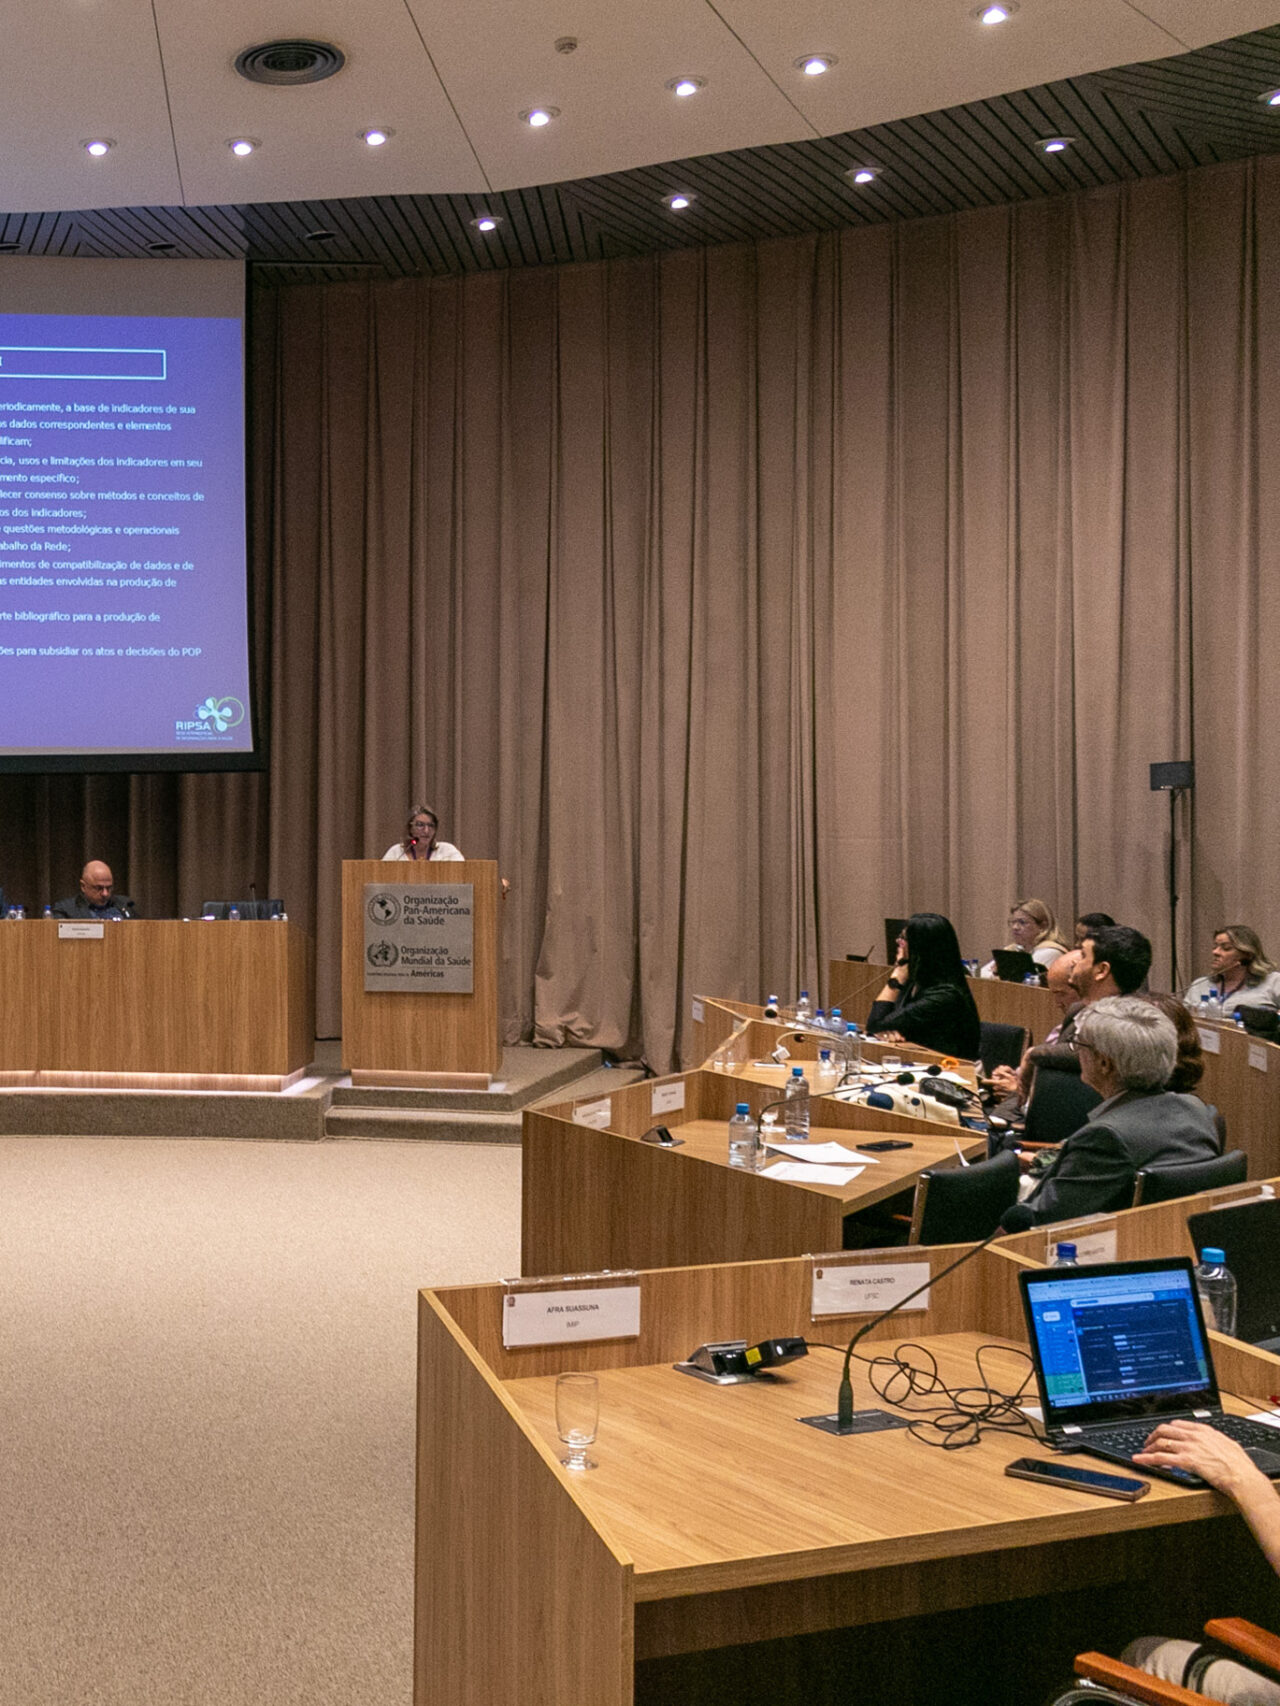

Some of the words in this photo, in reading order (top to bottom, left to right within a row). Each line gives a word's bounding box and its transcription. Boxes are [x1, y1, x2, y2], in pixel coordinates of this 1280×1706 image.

[73, 402, 96, 412] base
[111, 403, 164, 413] indicadores
[179, 406, 196, 414] sua
[8, 419, 38, 428] dados
[38, 419, 116, 431] correspondentes
[125, 420, 172, 430] elementos
[18, 457, 40, 465] usos
[49, 456, 96, 468] limitações
[97, 456, 114, 466] dos
[116, 456, 169, 466] indicadores
[186, 459, 203, 467] seu
[24, 491, 68, 499] consenso
[69, 489, 96, 499] sobre
[97, 490, 137, 500] métodos
[146, 490, 191, 501] conceitos
[11, 507, 29, 517] dos
[31, 507, 87, 519] indicadores;
[2, 523, 45, 535] questões
[47, 524, 113, 536] metodológicas
[122, 525, 180, 537] operacionais
[44, 541, 71, 552] Rede;
[52, 559, 128, 572] compatibilização
[143, 560, 172, 570] dados
[8, 576, 54, 585] entidades
[55, 576, 104, 586] envolvidas
[119, 577, 163, 588] produção
[14, 611, 71, 623] bibliográfico
[72, 613, 93, 623] para
[103, 611, 147, 624] produção
[16, 647, 37, 657] para
[38, 645, 79, 655] subsidiar
[95, 647, 115, 656] atos
[125, 646, 166, 656] decisões
[175, 721, 211, 731] RIPSA
[403, 895, 459, 907] Organização
[403, 906, 470, 916] Pan-Americana
[403, 916, 415, 925] da
[417, 916, 445, 925] Saúde
[400, 945, 449, 957] Organização
[400, 956, 433, 965] Mundial
[435, 956, 445, 965] da
[446, 956, 471, 965] Saúde
[410, 969, 445, 978] Américas
[547, 1306, 564, 1314] AFRA
